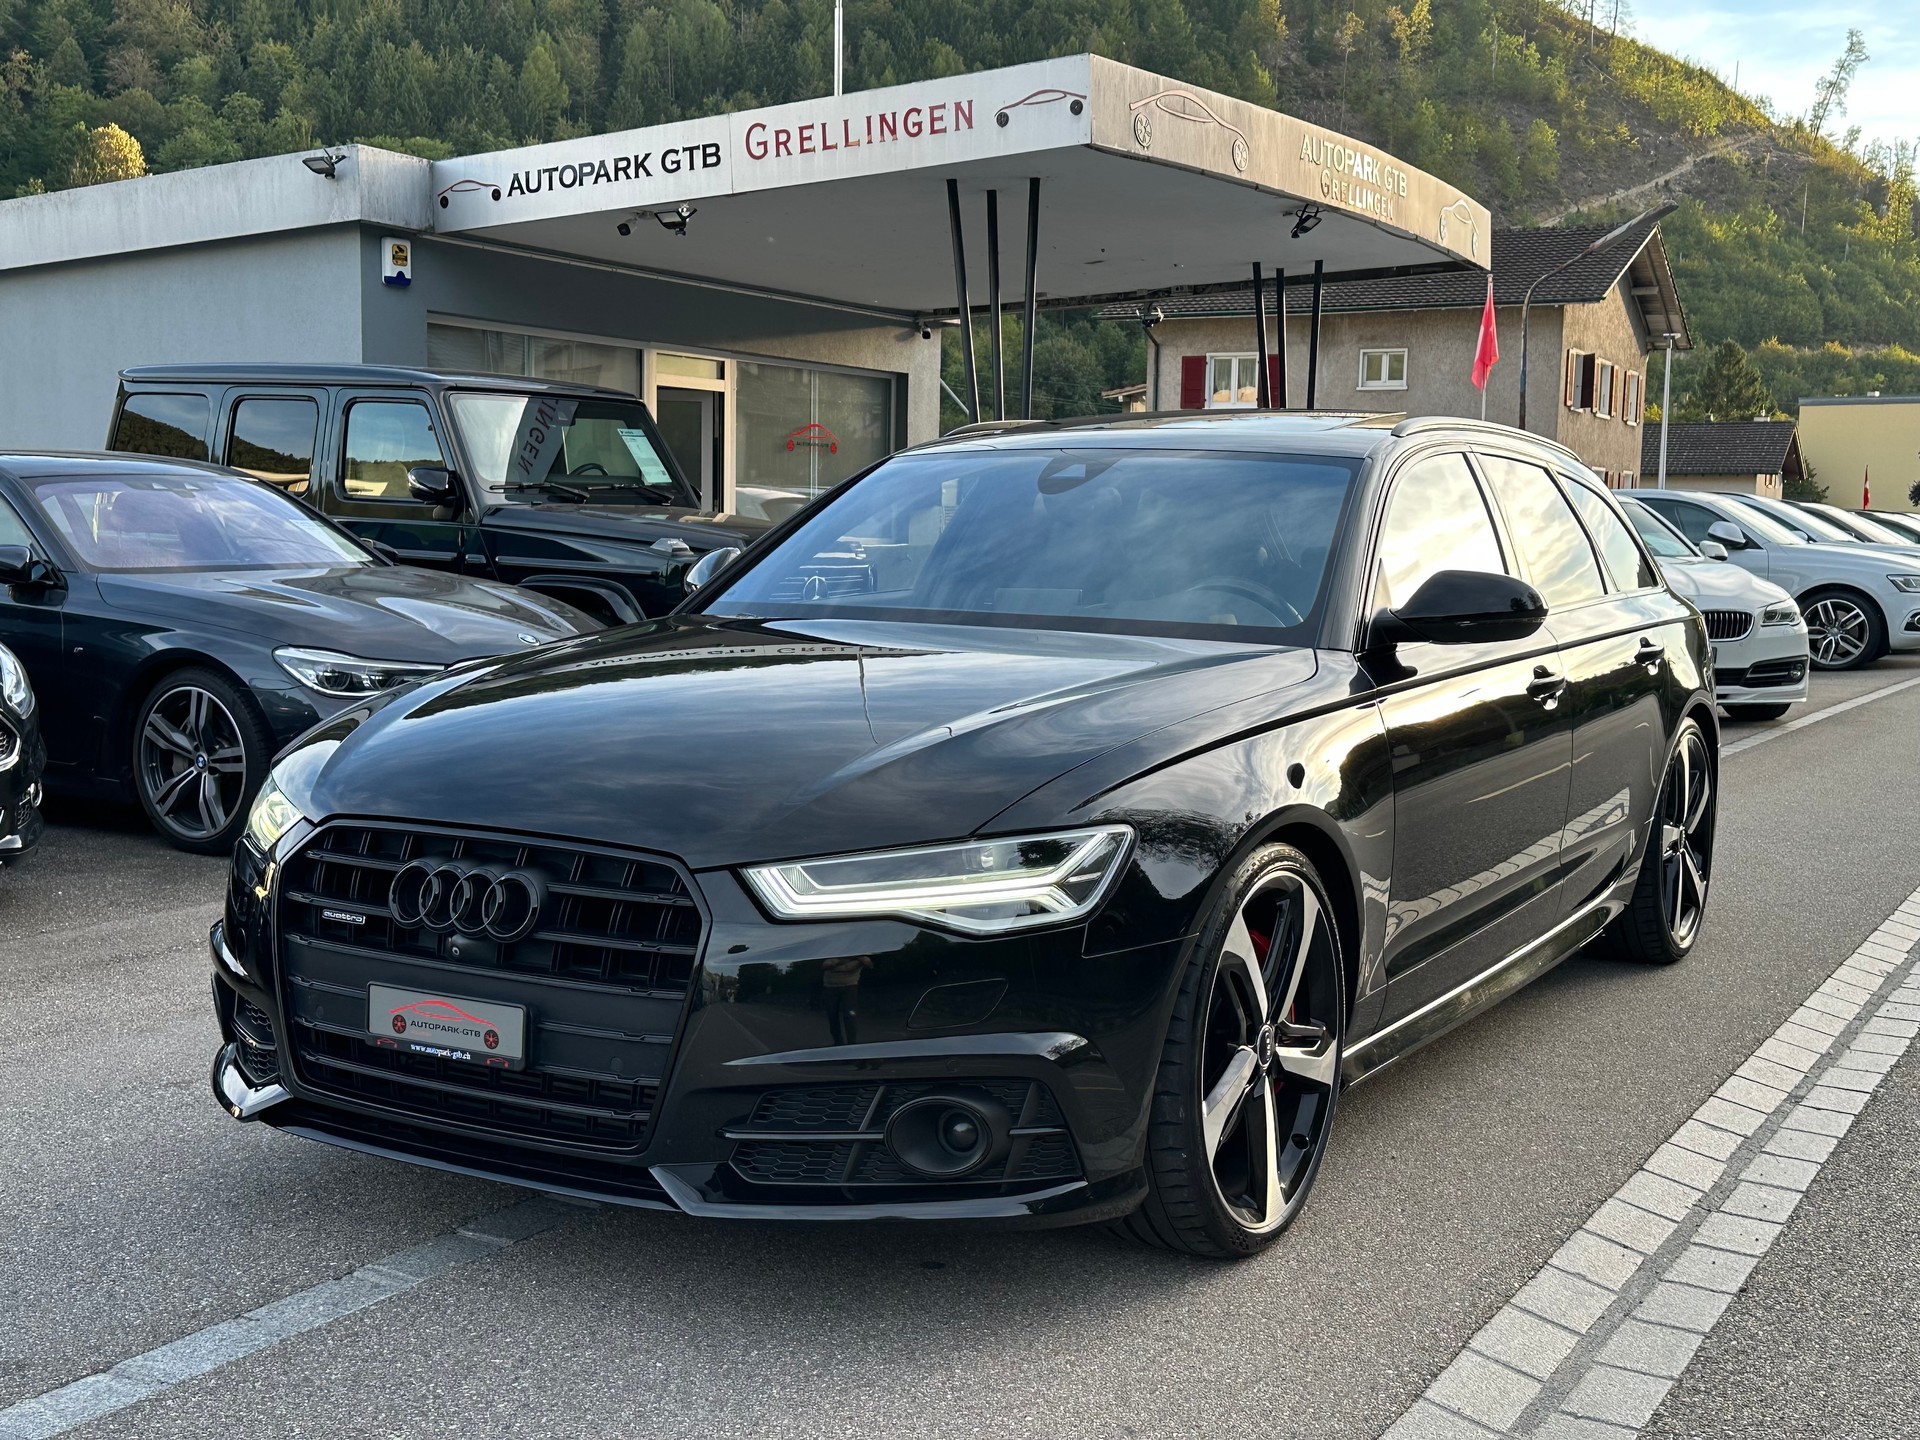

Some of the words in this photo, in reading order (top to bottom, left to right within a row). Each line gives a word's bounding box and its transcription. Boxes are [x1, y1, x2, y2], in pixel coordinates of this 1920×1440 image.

[507, 152, 653, 197] AUTOPARK
[661, 142, 721, 174] GTB
[745, 99, 974, 160] GRELLINGEN
[1300, 134, 1381, 188] AUTOPARK
[1384, 164, 1408, 198] GTB
[1320, 169, 1394, 220] GRELLINGEN
[323, 911, 363, 922] quattro
[410, 1020, 481, 1038] AUTOPARK-GTB
